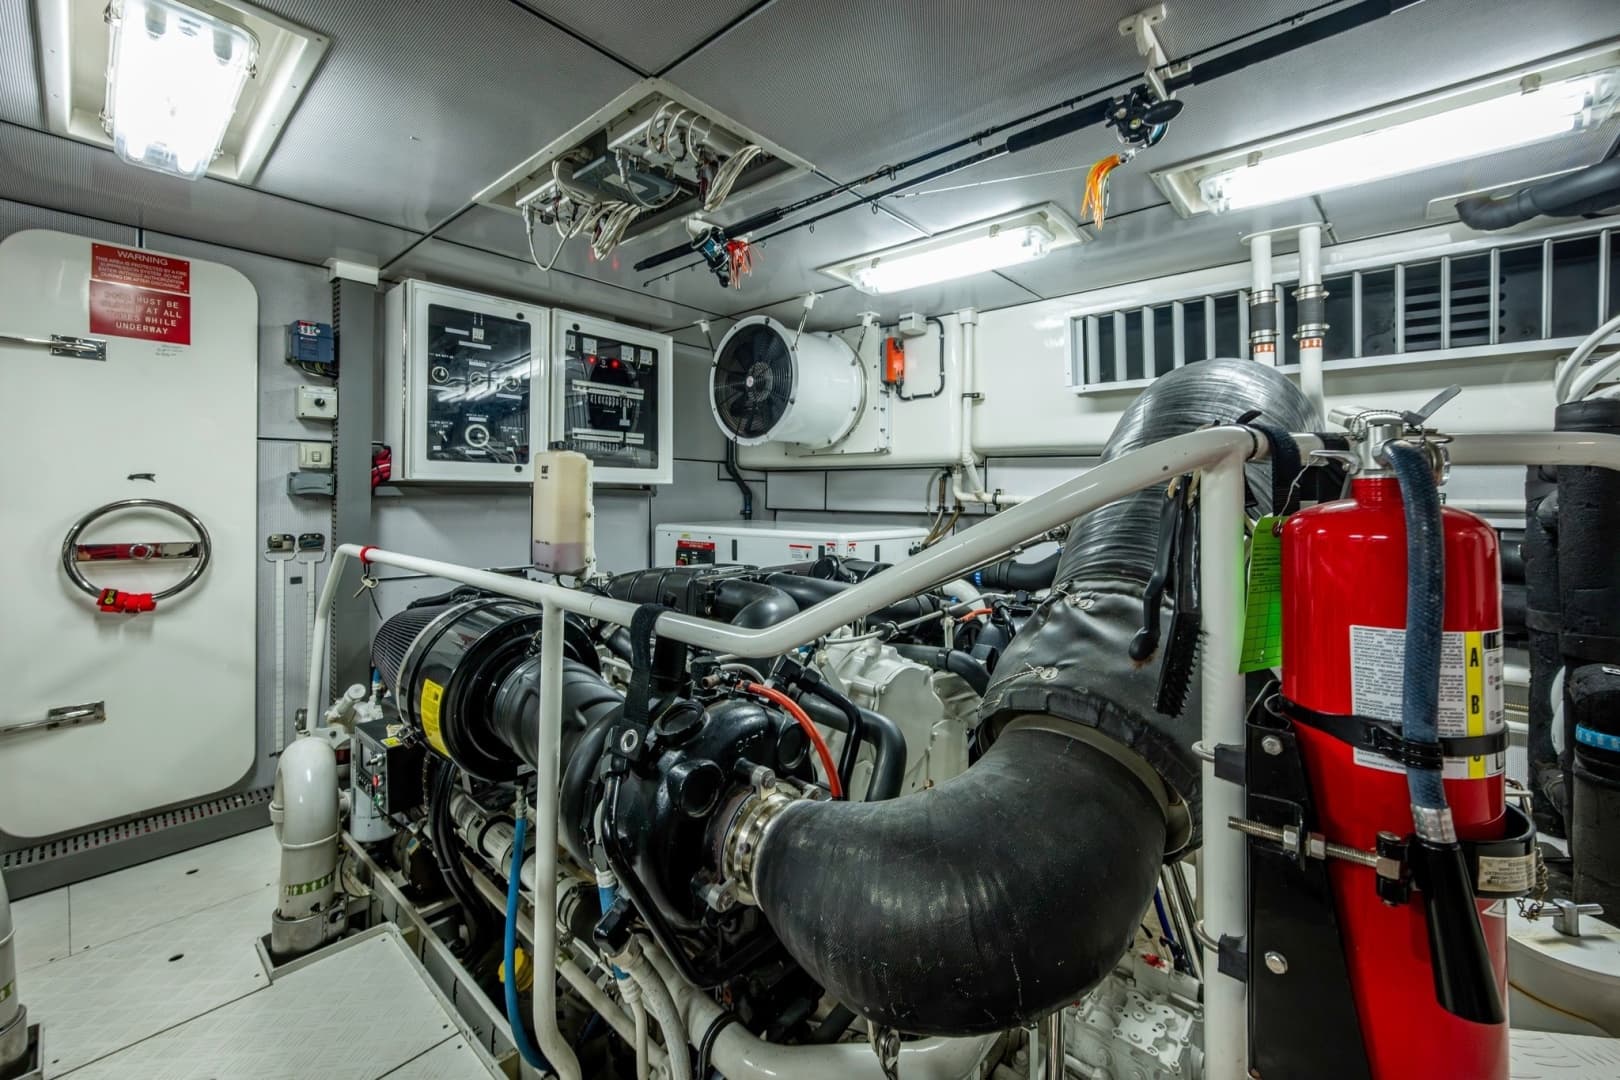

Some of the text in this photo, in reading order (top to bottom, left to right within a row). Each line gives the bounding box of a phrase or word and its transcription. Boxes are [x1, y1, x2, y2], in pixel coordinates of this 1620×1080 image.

[117, 250, 168, 266] WARNING
[166, 300, 179, 308] BE
[163, 309, 181, 318] ALL
[145, 316, 176, 327] WHILE
[116, 322, 168, 334] UNDERWAY
[1470, 648, 1479, 667] A
[1472, 694, 1479, 714] B
